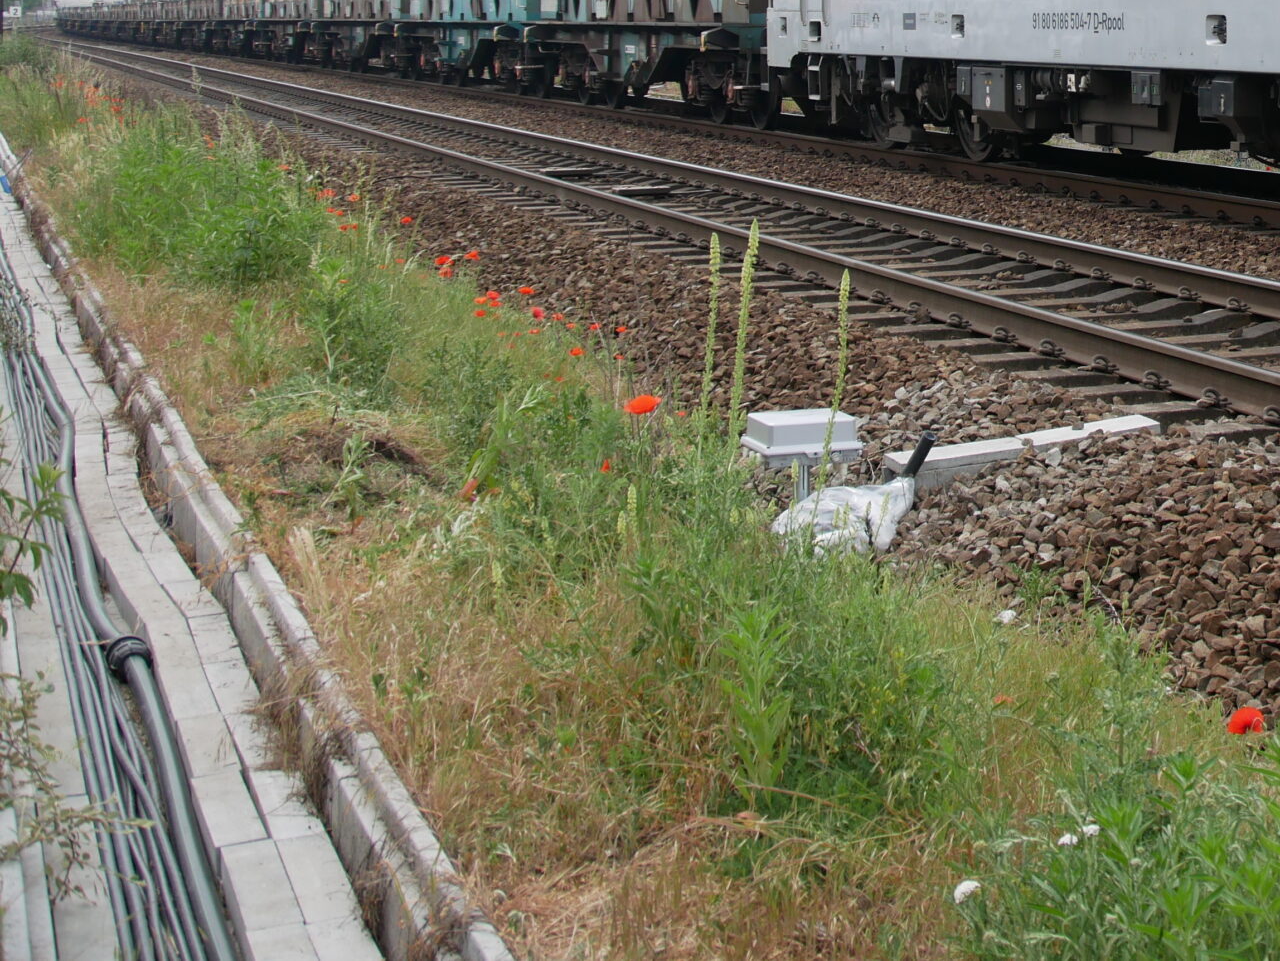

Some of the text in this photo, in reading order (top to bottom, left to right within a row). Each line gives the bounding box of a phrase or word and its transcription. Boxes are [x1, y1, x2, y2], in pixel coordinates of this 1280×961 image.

[1032, 12, 1125, 35] 91 80 6186 504-7 D-Rpool
